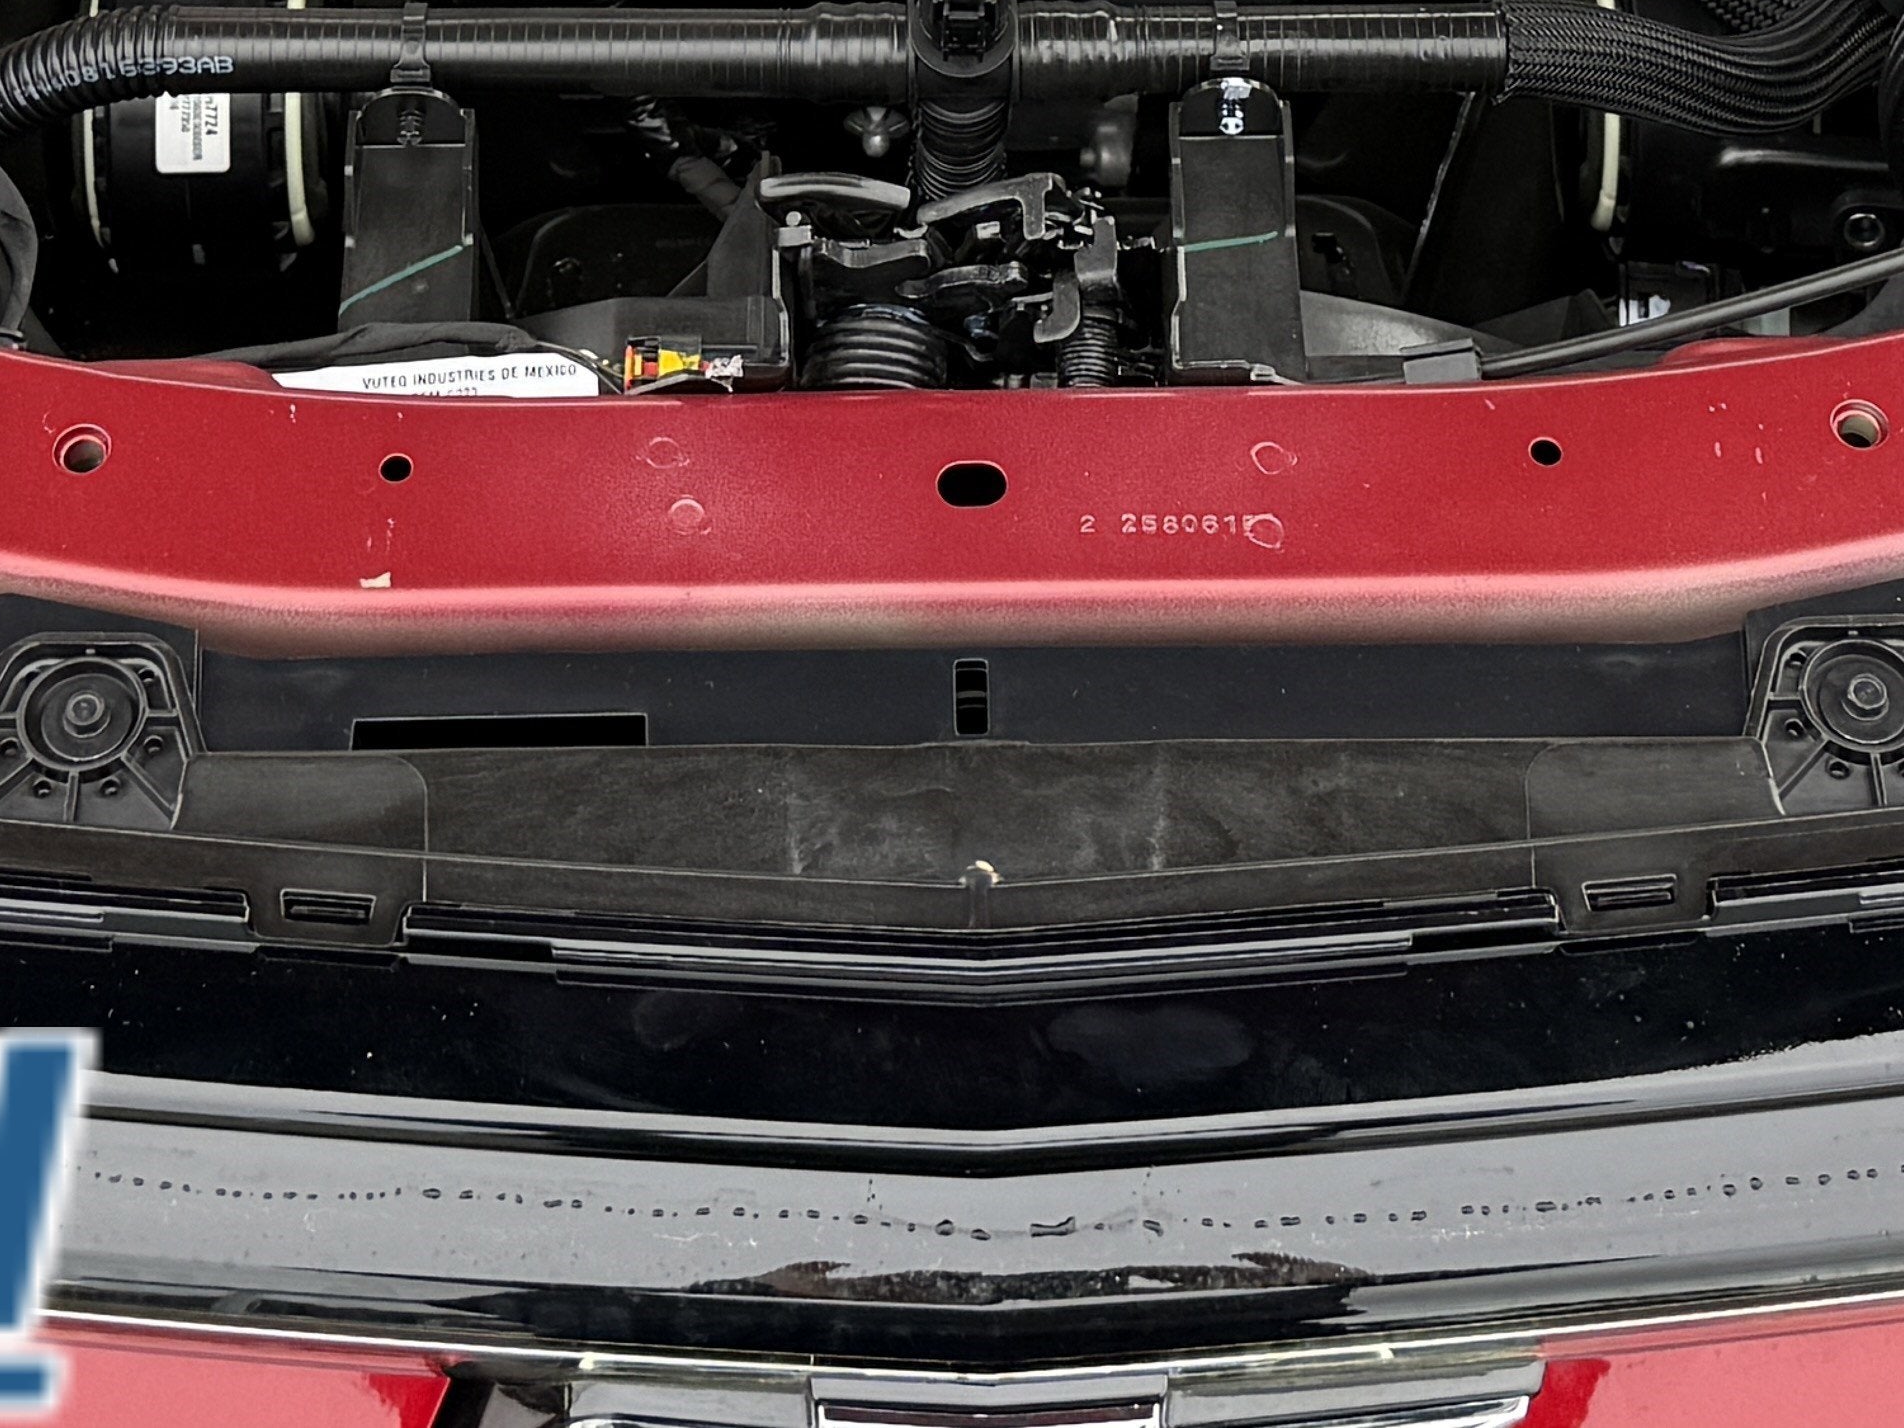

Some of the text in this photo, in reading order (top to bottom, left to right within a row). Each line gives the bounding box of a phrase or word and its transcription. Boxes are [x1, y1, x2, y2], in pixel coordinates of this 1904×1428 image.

[413, 368, 495, 385] INDUSTRIES
[502, 366, 519, 380] DE
[525, 363, 577, 377] MEXICO
